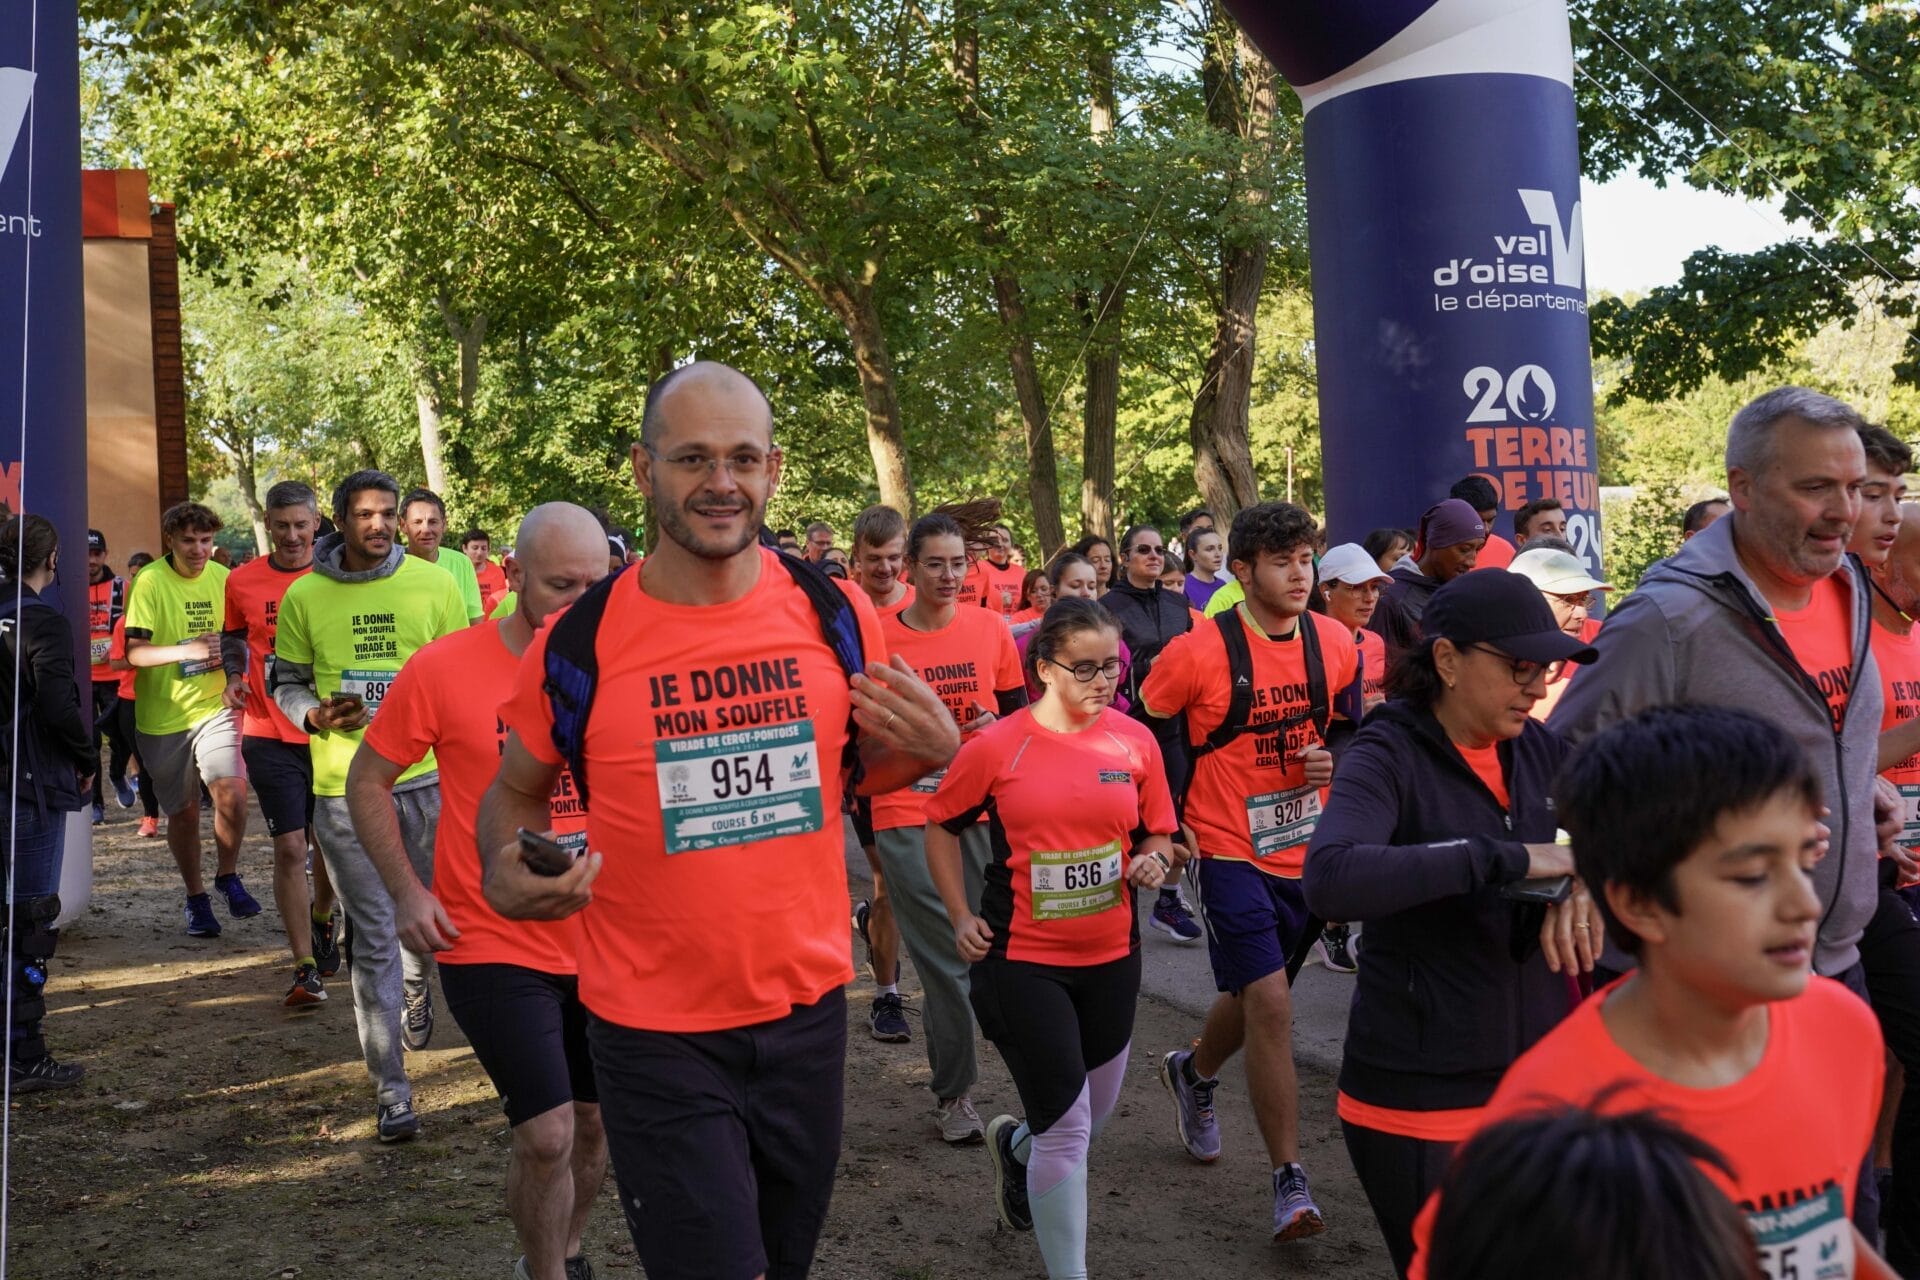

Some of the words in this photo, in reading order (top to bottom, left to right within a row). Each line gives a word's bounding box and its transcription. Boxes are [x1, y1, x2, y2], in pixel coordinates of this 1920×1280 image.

[1494, 230, 1547, 256] val
[1434, 257, 1549, 286] d'oise
[1434, 293, 1458, 312] le
[1466, 427, 1588, 468] TERRE
[192, 601, 213, 609] DONNE
[265, 601, 277, 614] JE
[352, 615, 361, 626] JE
[363, 613, 396, 625] DONNE
[353, 627, 368, 635] MON
[369, 625, 396, 634] SOUFFLE
[354, 642, 384, 653] VIRADE
[386, 641, 398, 651] DE
[924, 662, 977, 682] DONNE
[365, 682, 392, 701] 89
[649, 674, 681, 709] JE
[690, 657, 803, 703] DONNE
[936, 680, 979, 696] SOUFFLE
[1892, 682, 1906, 701] JE
[954, 697, 964, 706] LA
[1252, 689, 1267, 709] JE
[654, 710, 708, 737] MON
[715, 695, 808, 728] SOUFFLE
[1252, 709, 1279, 724] MON
[669, 739, 705, 753] VIRADE
[707, 737, 719, 748] DE
[721, 725, 799, 746] CERGY-PONTOISE
[1254, 733, 1305, 755] VIRDE
[711, 753, 774, 799] 954
[712, 818, 746, 831] COURSE
[750, 810, 759, 825] 6
[763, 812, 776, 823] KM
[1274, 799, 1302, 826] 920
[1064, 861, 1102, 890] 636
[1057, 901, 1080, 910] COURSE
[1081, 897, 1087, 906] 6
